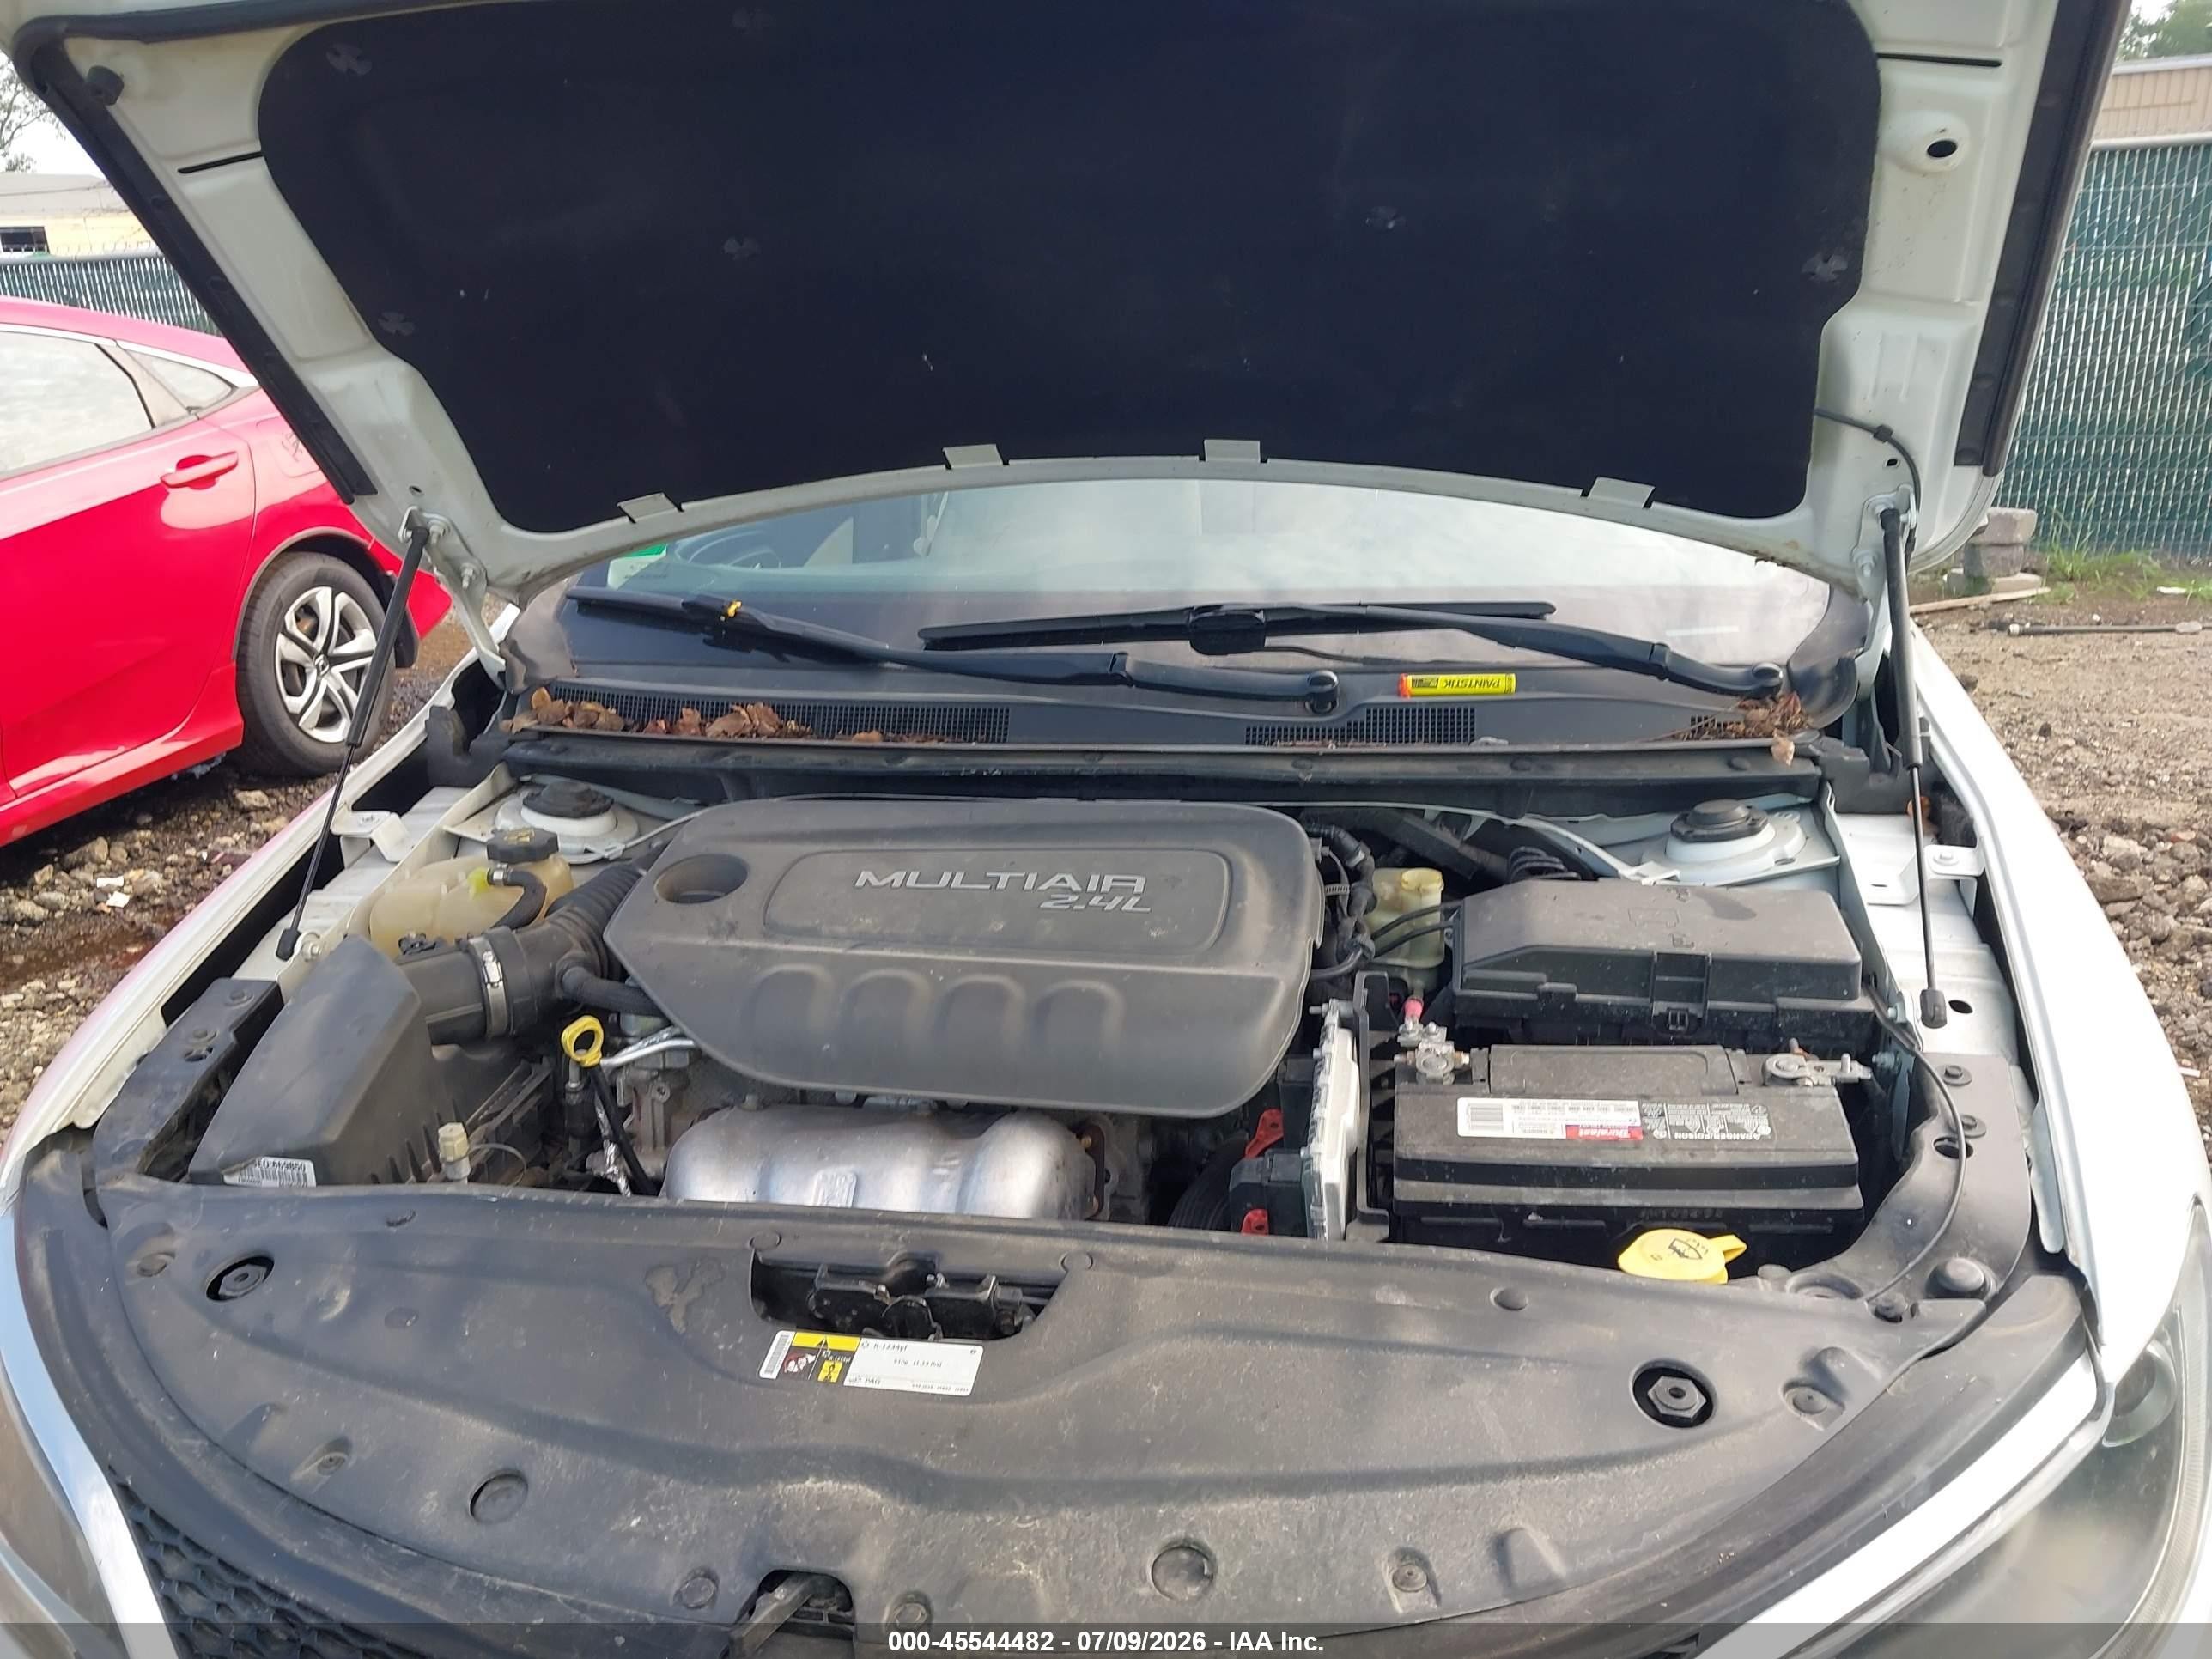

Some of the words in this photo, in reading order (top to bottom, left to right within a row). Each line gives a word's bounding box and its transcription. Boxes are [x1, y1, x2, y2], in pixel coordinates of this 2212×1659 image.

[1444, 678, 1502, 688] PAINTSTIK
[854, 870, 1147, 895] MULTIAIR
[1039, 893, 1152, 914] 2.4L
